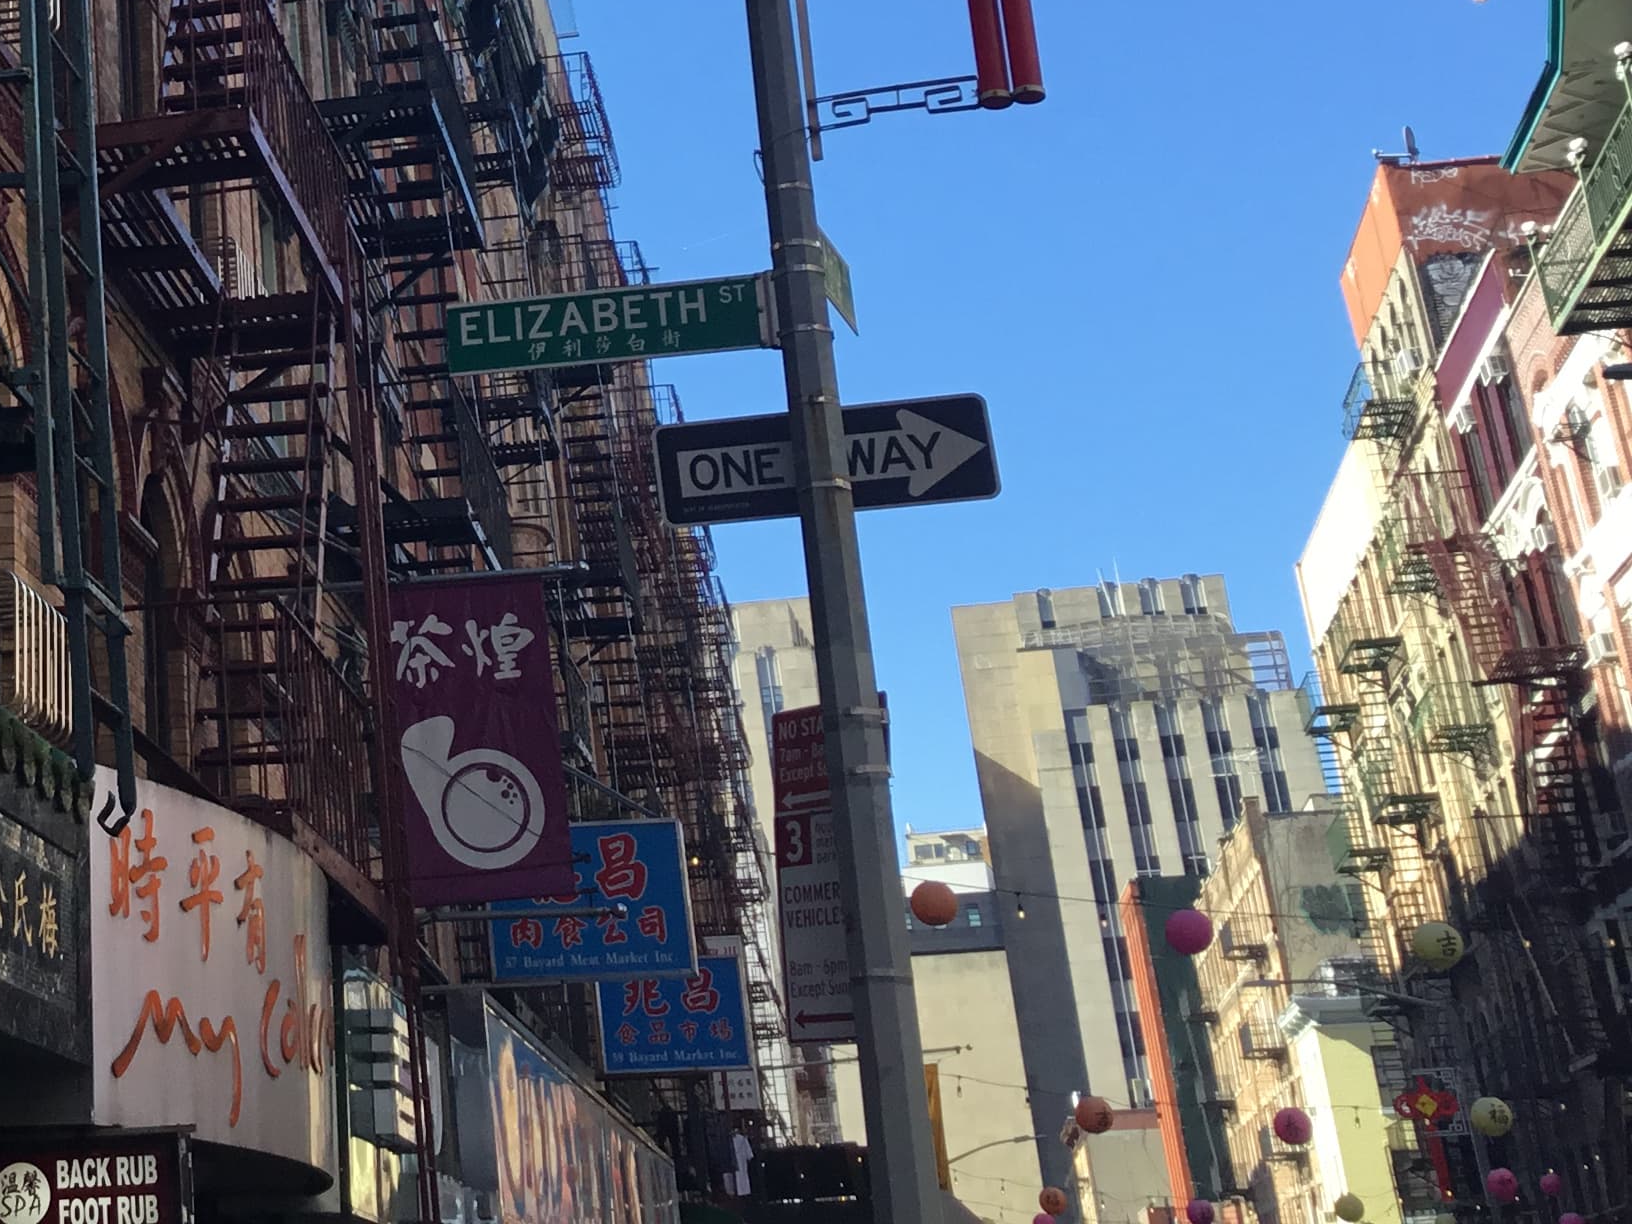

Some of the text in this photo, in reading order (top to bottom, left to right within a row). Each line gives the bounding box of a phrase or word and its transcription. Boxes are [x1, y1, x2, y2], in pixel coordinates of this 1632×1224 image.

[459, 283, 746, 346] ELIZABETH ST
[528, 329, 681, 360] 伊利莎白街
[689, 431, 942, 491] ONE WAY
[778, 719, 798, 741] NO
[779, 764, 814, 783] Except
[786, 820, 804, 864] 3
[784, 881, 841, 905] COMMER
[511, 906, 668, 949] 肉食公司
[1436, 930, 1457, 957] 吉
[523, 952, 566, 969] Bayard
[571, 952, 600, 966] Meat
[606, 950, 649, 965] Market
[789, 960, 814, 977] 8am
[790, 978, 849, 999] Except Sun
[112, 990, 241, 1128] My
[629, 1050, 669, 1064] Bayard
[674, 1049, 717, 1062] Market
[56, 1154, 159, 1190] BACK RUB
[0, 1194, 42, 1218] SPA
[58, 1194, 160, 1224] FOOT RUB
